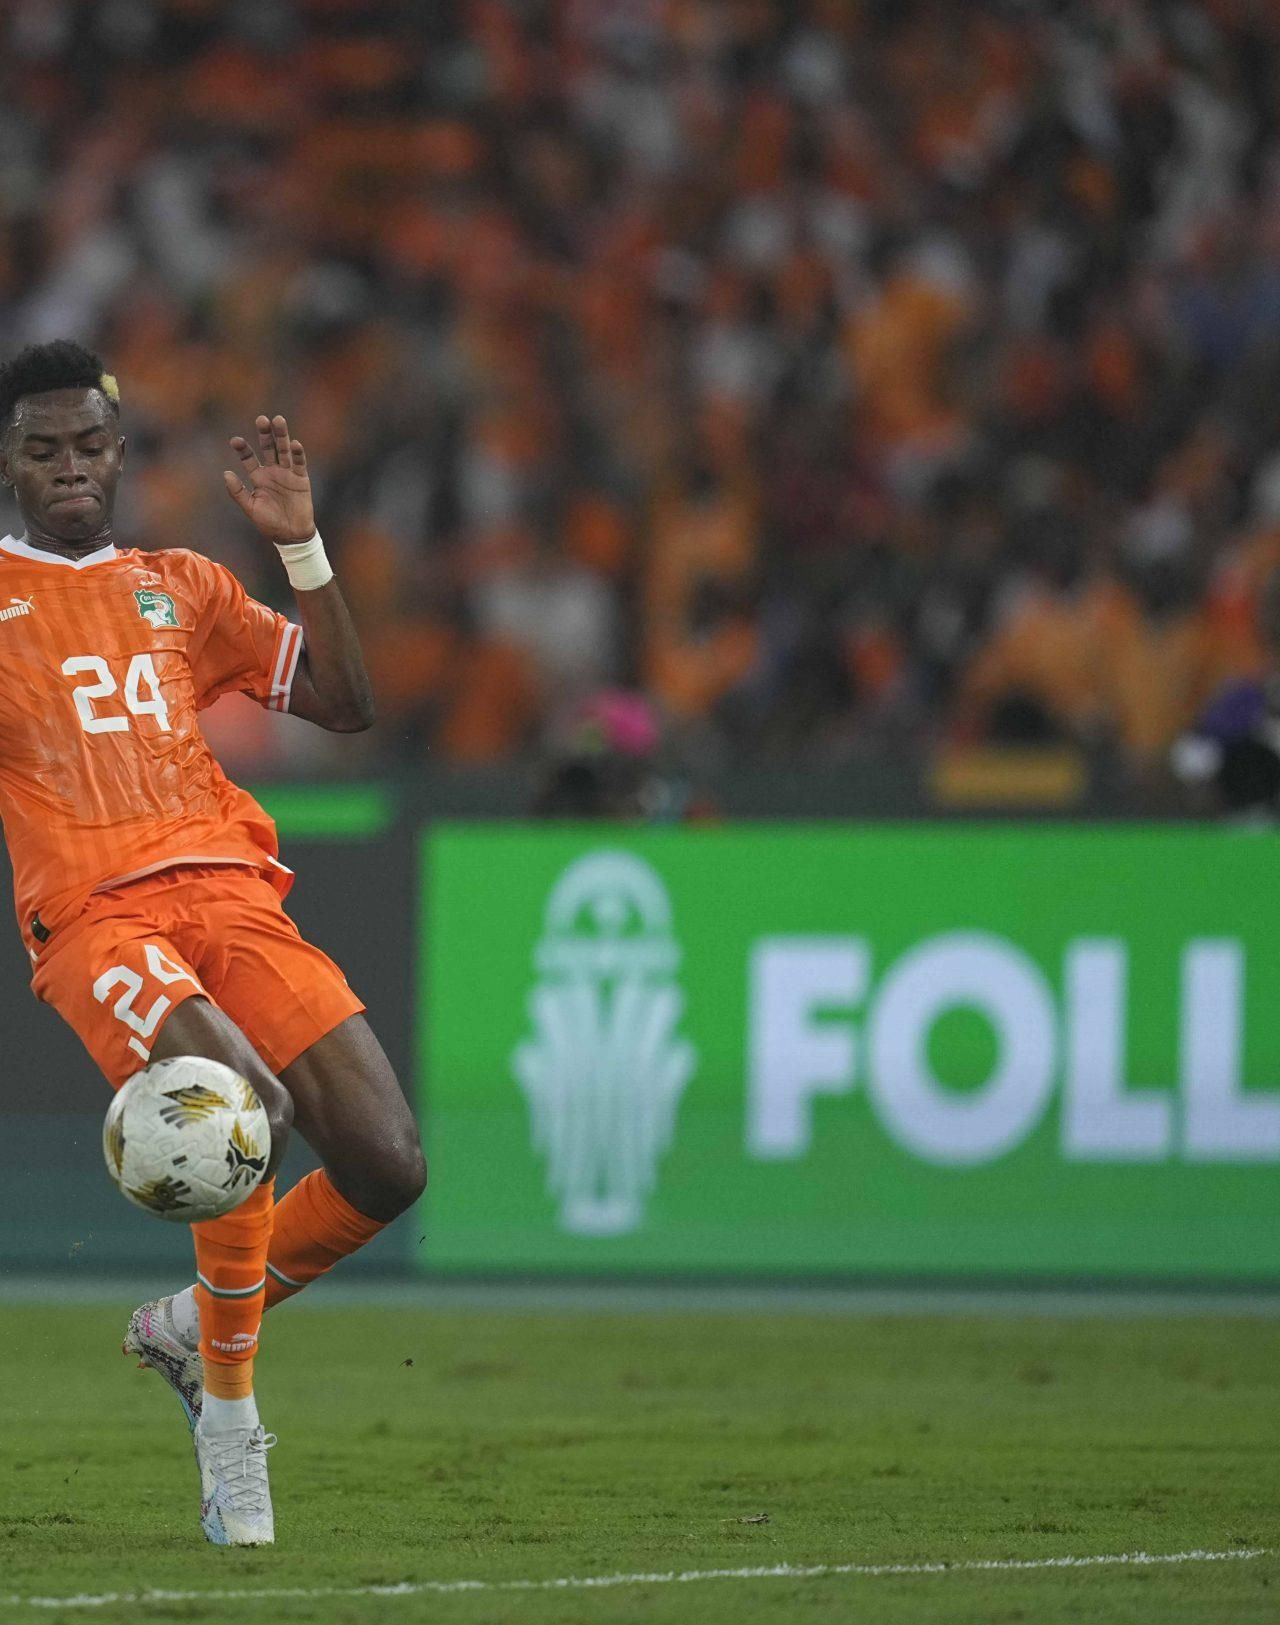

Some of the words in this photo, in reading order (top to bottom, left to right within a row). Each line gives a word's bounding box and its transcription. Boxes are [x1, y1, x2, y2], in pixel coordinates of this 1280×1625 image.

[61, 654, 172, 734] 24
[93, 944, 204, 1039] 24
[747, 929, 1280, 1166] FOLL
